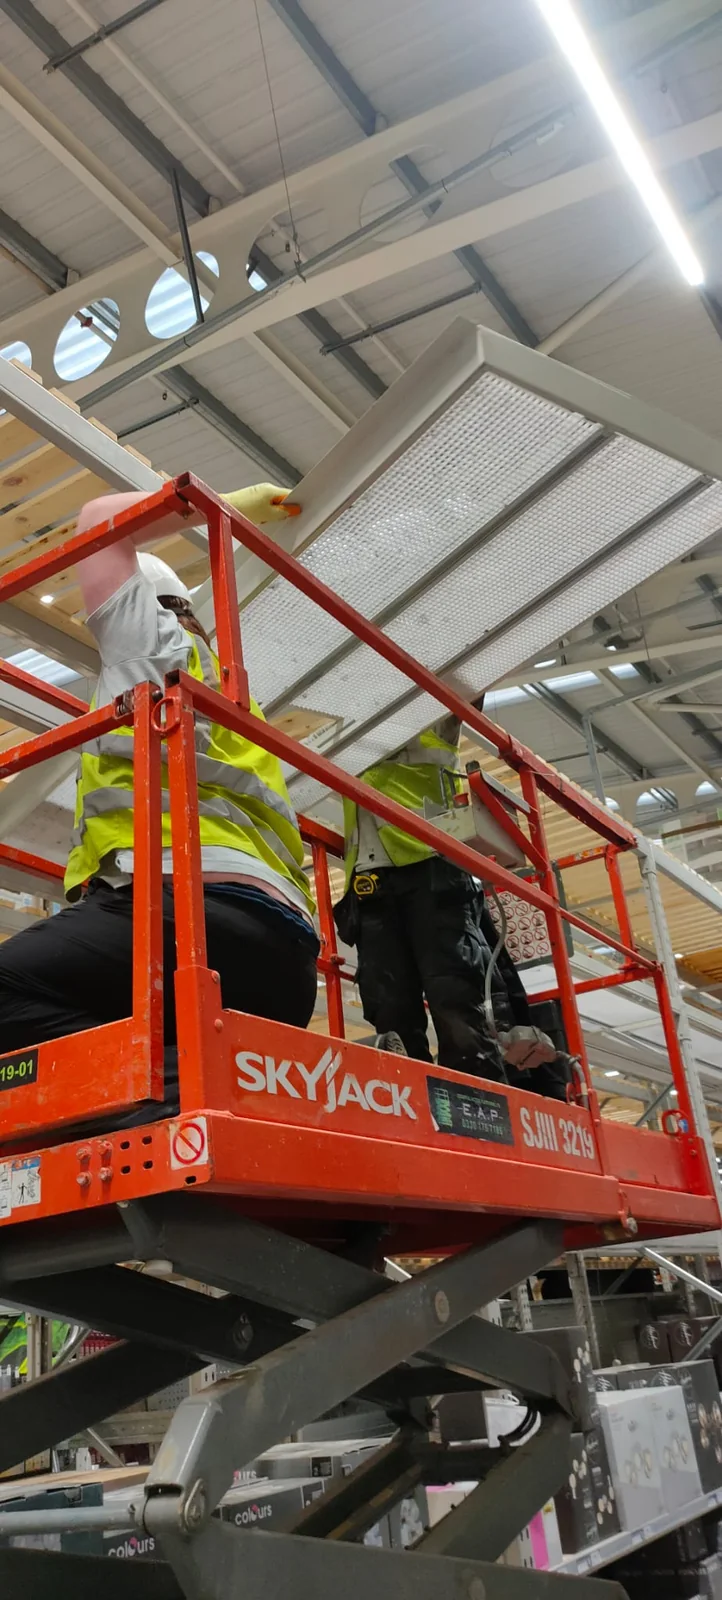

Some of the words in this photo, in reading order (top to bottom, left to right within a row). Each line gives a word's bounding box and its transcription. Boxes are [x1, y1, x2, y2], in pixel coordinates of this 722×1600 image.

[0, 1059, 33, 1082] 19-01
[235, 1046, 417, 1120] SKYJACK
[558, 1118, 595, 1160] 3219
[235, 1504, 272, 1525] colours
[108, 1536, 155, 1558] colours
